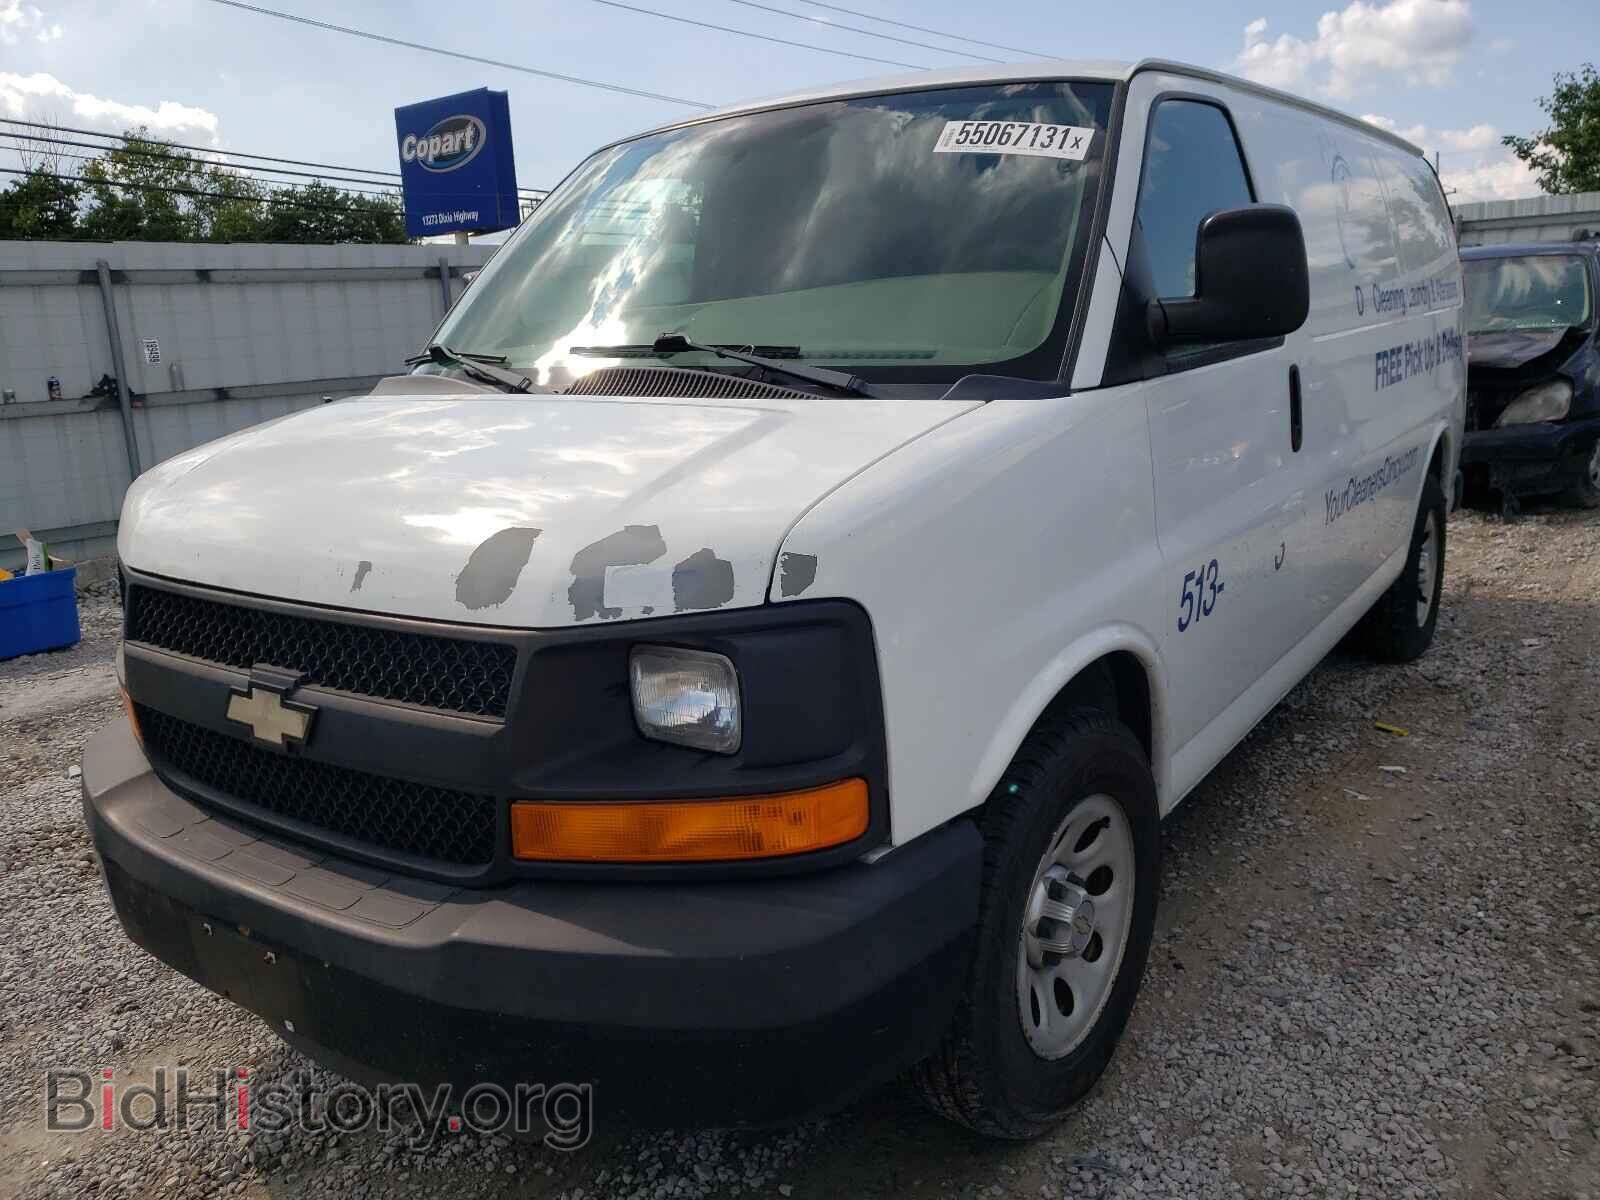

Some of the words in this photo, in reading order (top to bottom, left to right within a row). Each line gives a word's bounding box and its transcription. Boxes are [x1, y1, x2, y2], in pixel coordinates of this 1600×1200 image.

[402, 123, 475, 164] Copart
[438, 211, 453, 225] Dixie
[453, 210, 479, 224] Highway
[1375, 345, 1403, 392] FREE
[1405, 340, 1423, 380] Pick
[1424, 337, 1435, 376] Up
